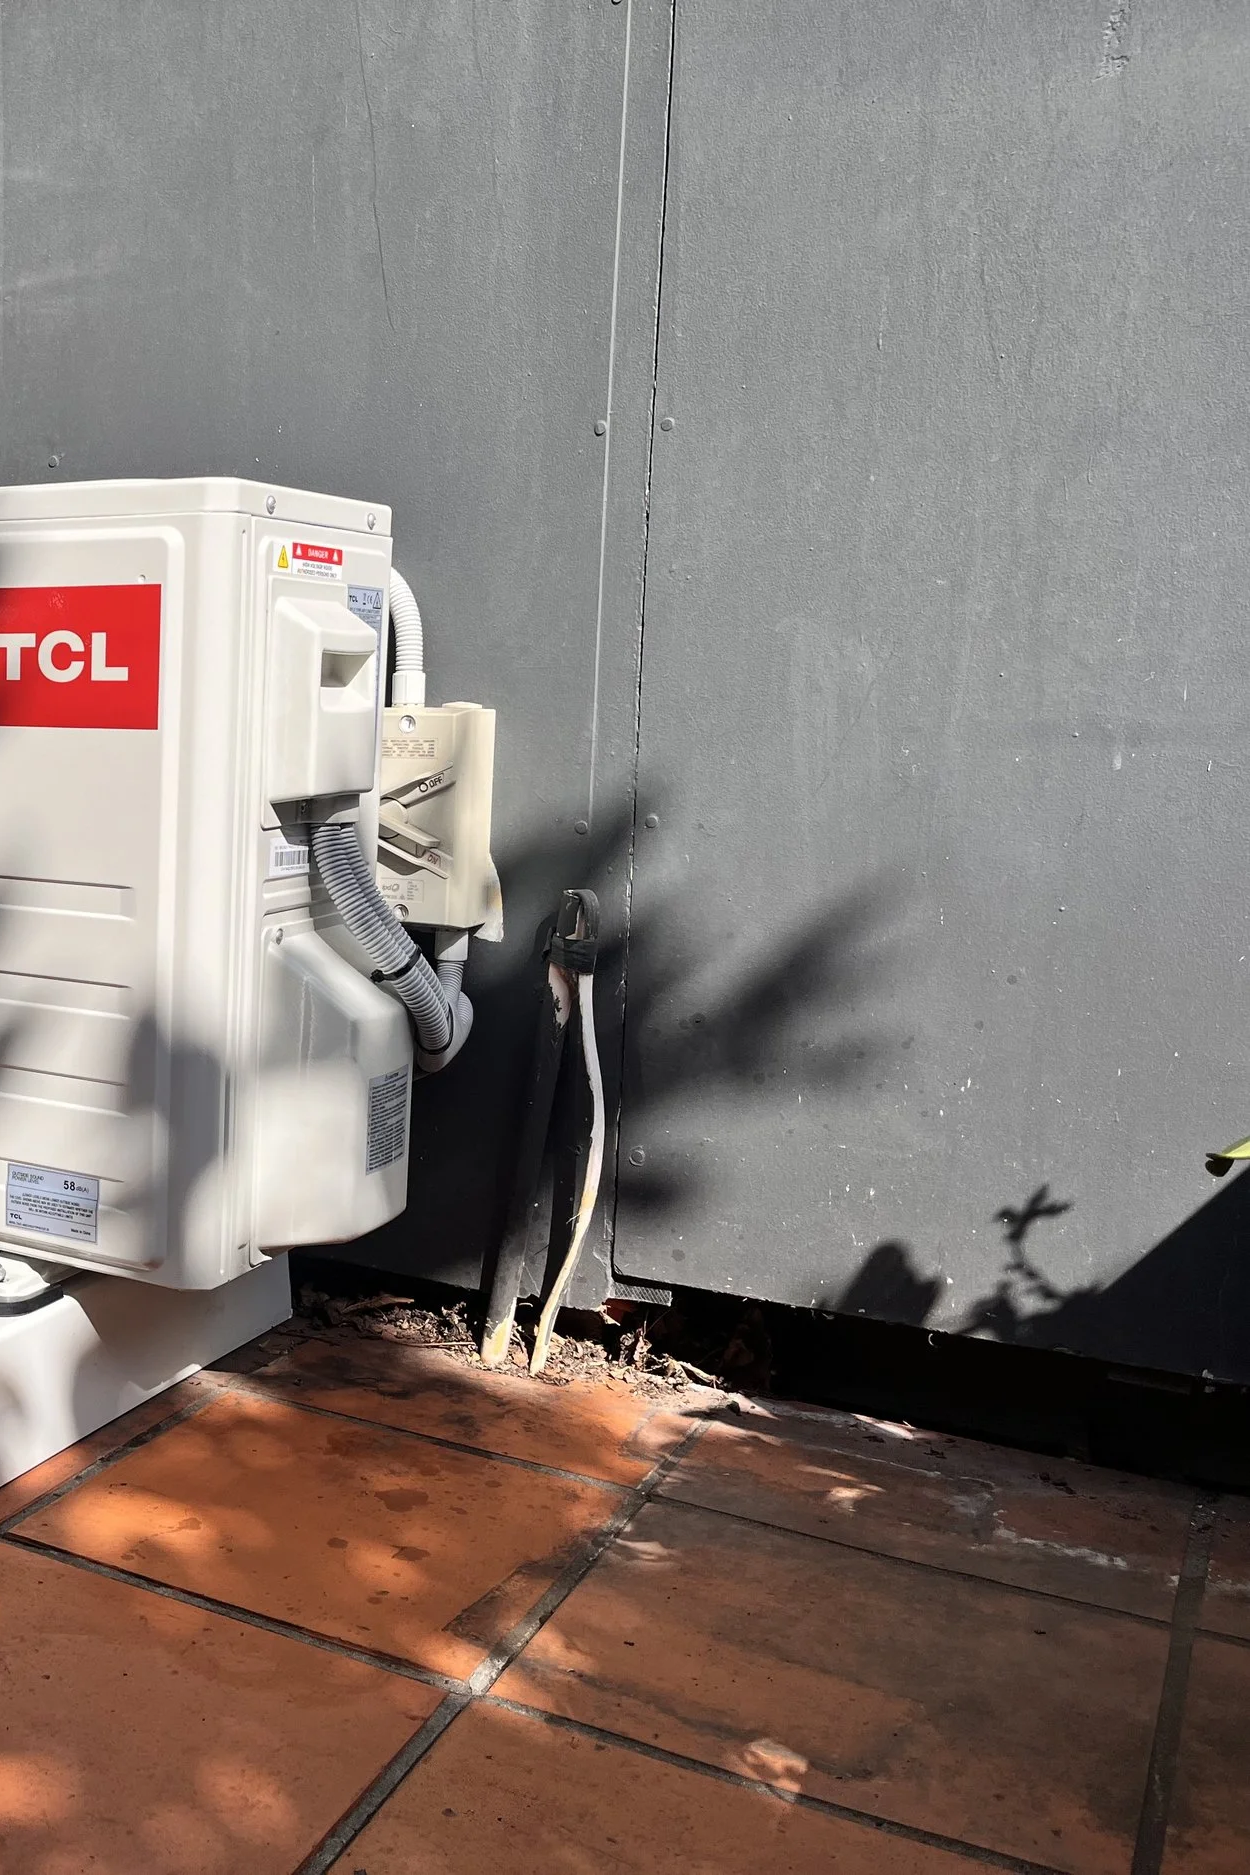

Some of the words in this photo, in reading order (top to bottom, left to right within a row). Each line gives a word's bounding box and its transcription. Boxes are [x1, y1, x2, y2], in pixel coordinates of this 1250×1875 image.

[307, 548, 329, 559] DANGER
[429, 776, 443, 788] OFF
[427, 854, 439, 865] ON
[63, 1180, 76, 1191] 58
[76, 1186, 90, 1194] dB(A)
